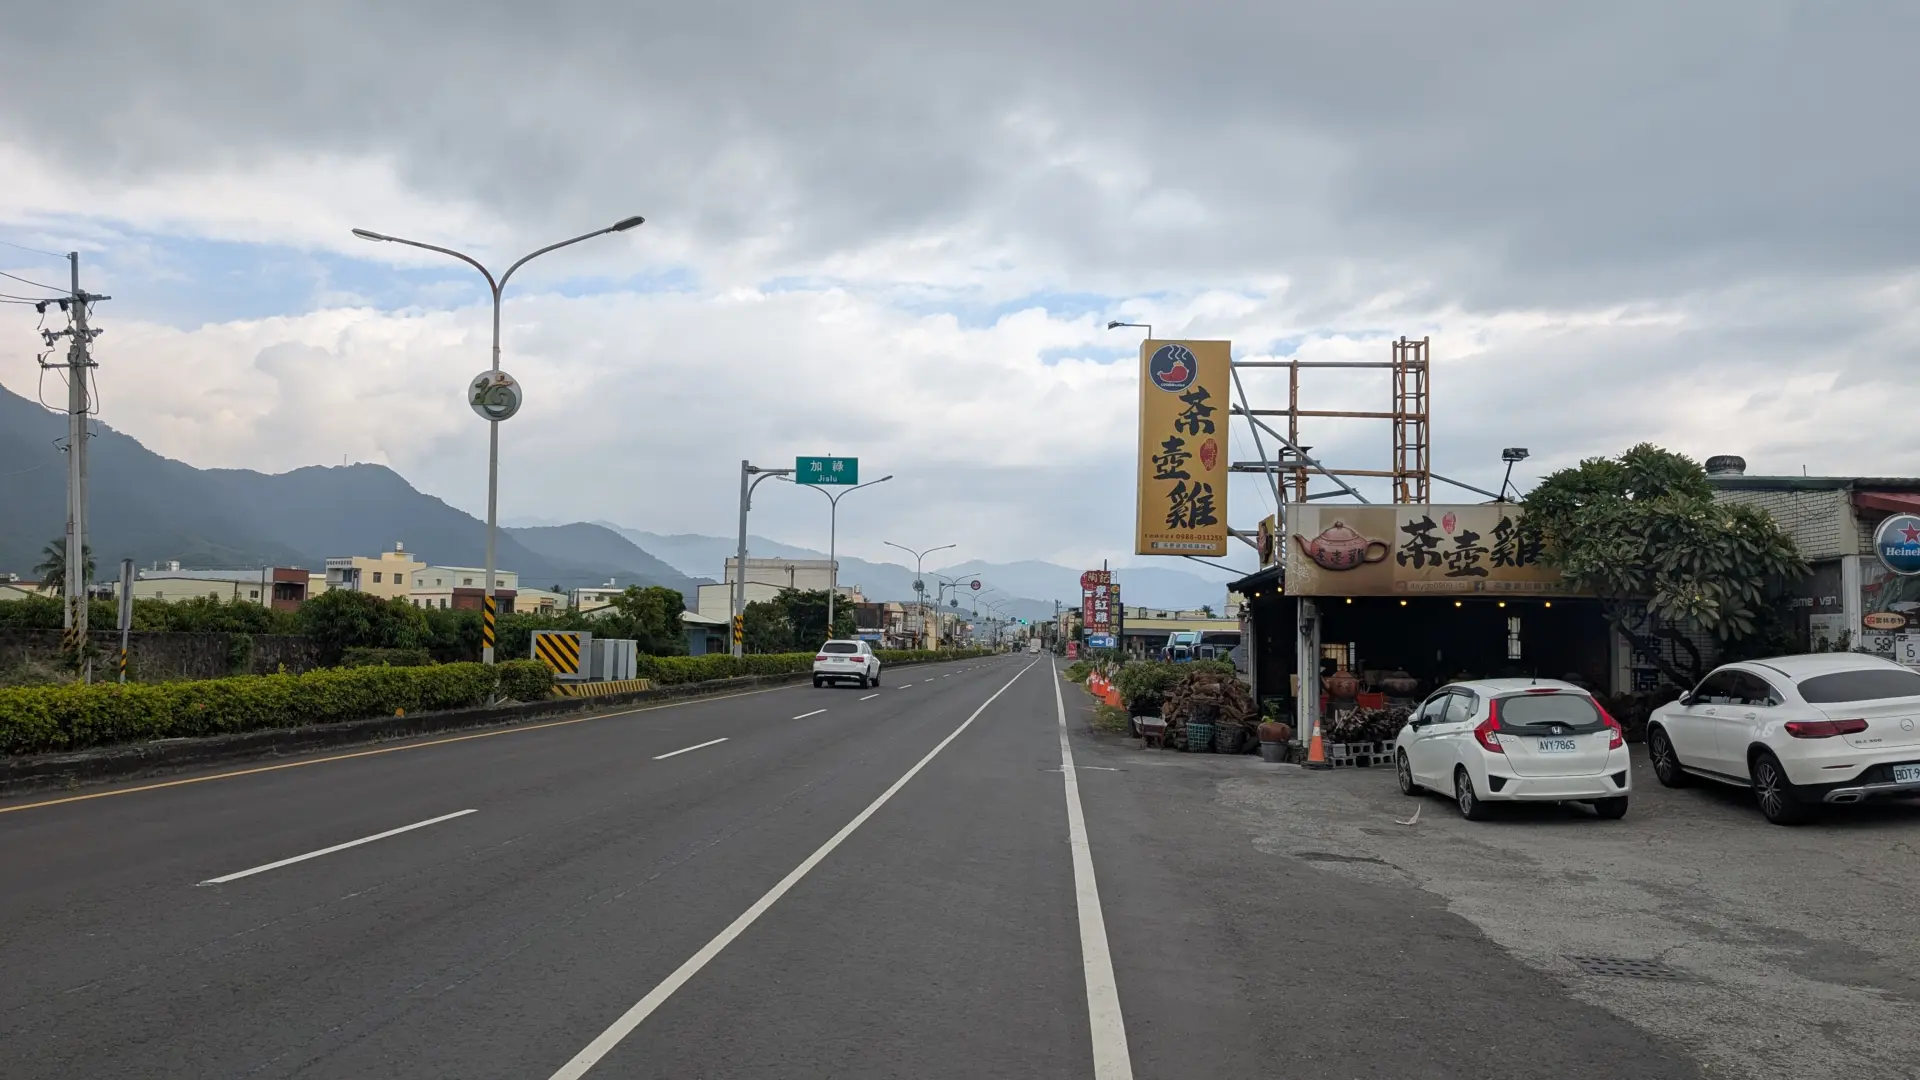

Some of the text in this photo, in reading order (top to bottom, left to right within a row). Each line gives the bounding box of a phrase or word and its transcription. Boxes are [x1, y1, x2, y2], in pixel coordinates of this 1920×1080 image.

[810, 460, 844, 472] 加祿
[817, 474, 838, 482] Jialu
[1886, 547, 1920, 556] Heine
